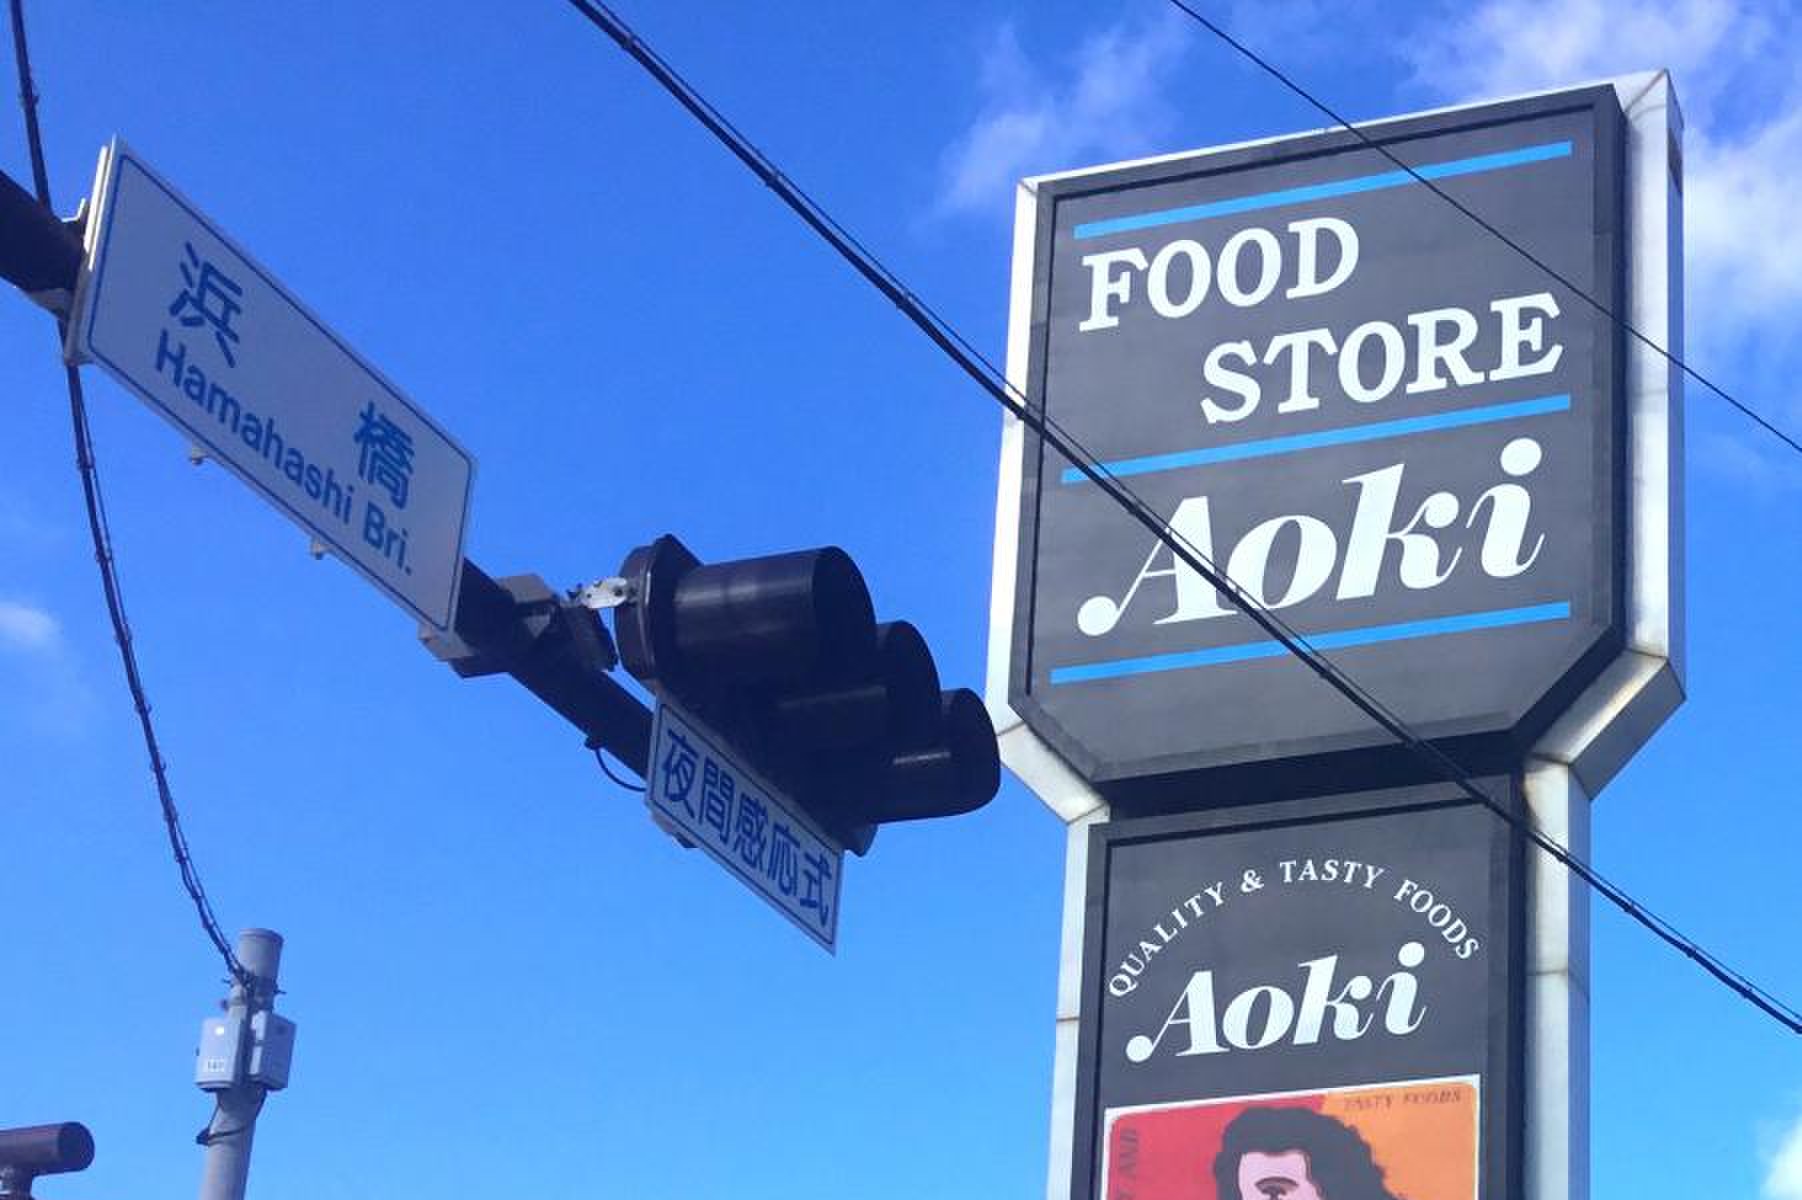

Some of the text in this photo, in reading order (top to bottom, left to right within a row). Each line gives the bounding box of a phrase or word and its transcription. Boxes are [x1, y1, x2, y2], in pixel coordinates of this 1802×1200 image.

[1079, 217, 1359, 332] FOOD
[1200, 293, 1563, 424] STORE
[155, 328, 413, 576] Hamahashi Bri.
[169, 242, 415, 510] 浜 橋
[1077, 438, 1545, 636] Aoki
[662, 728, 832, 927] 夜間感応式
[1108, 859, 1481, 998] QUALITY & TASTY FOODS
[1125, 941, 1427, 1063] Aoki
